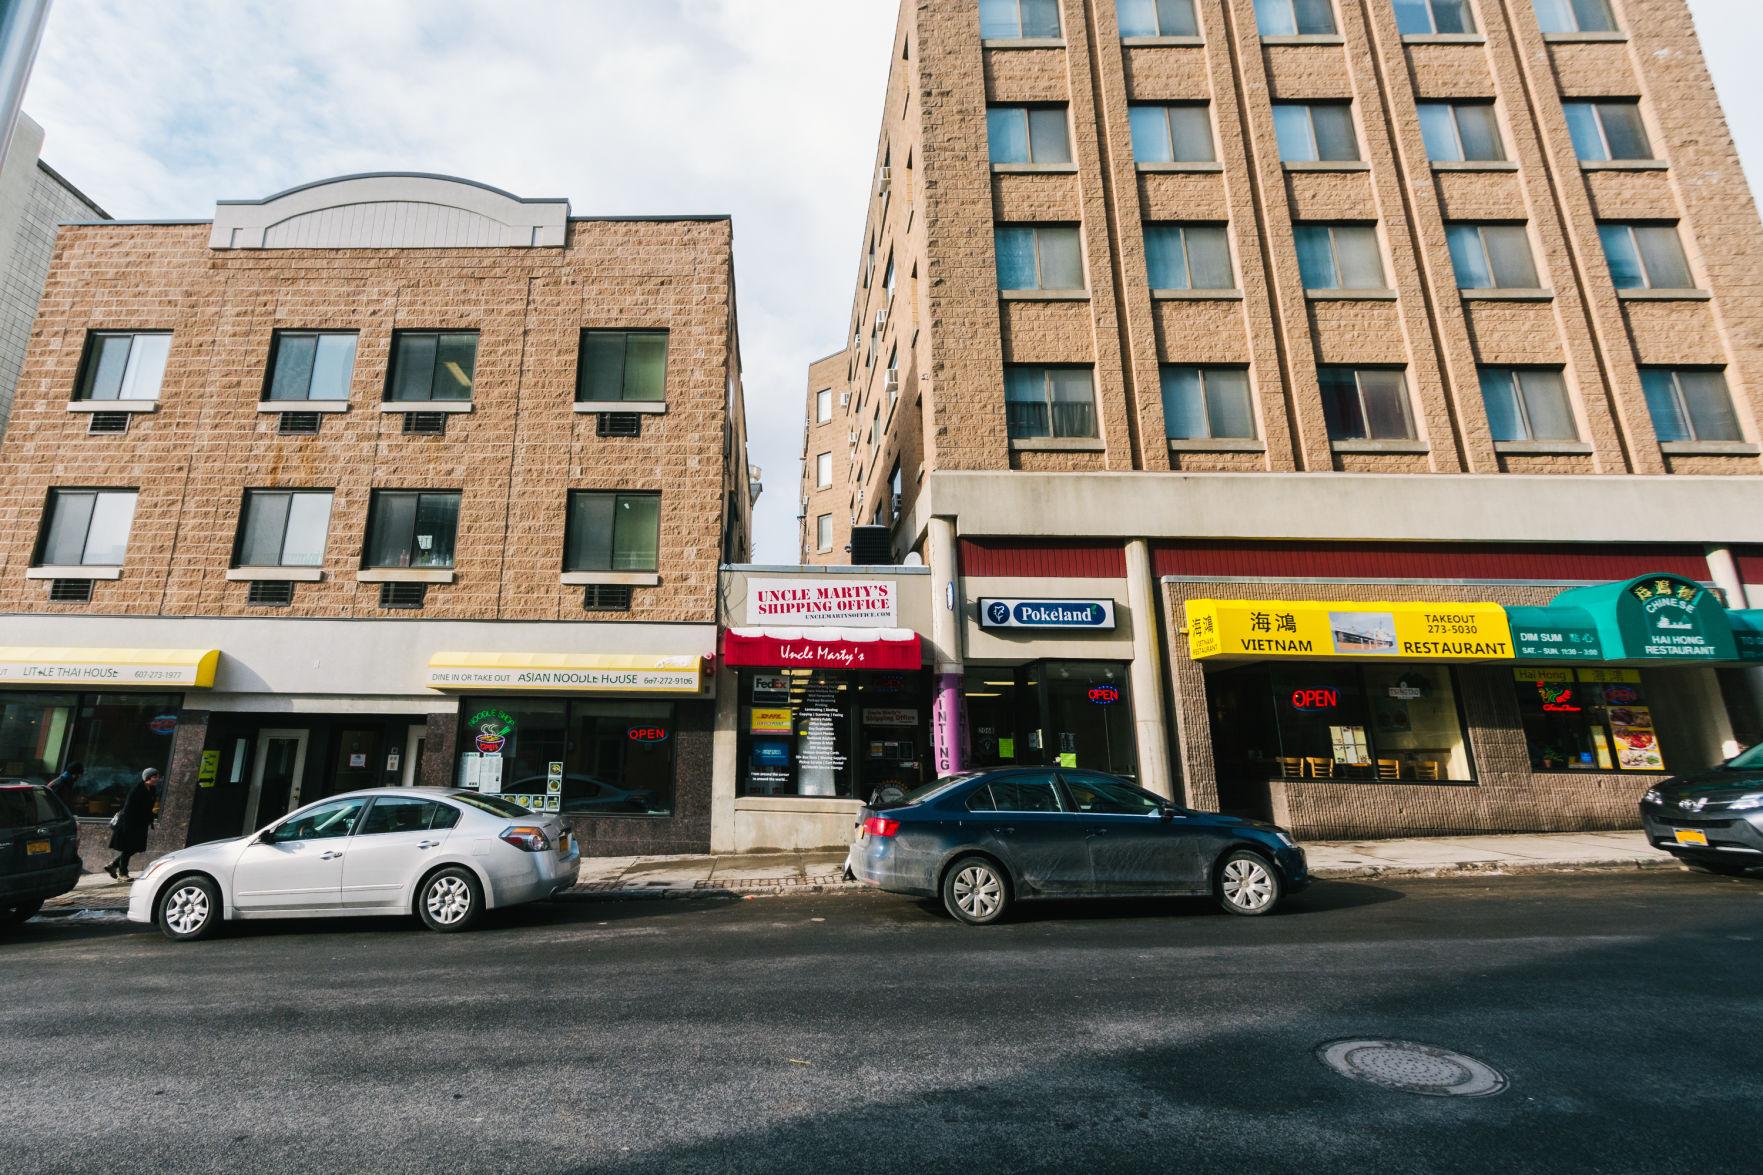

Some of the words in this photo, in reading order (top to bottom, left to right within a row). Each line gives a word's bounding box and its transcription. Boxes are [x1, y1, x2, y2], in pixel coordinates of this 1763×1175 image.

[758, 588, 811, 602] UNCLE
[817, 584, 889, 600] MARTY'S
[758, 601, 832, 615] SHIPPING
[837, 598, 890, 612] OFFICE
[1646, 597, 1696, 614] CHINESE
[805, 611, 891, 620] UNCLEMARTYSOFFICE.COM
[1021, 606, 1093, 622] Pokéland
[1424, 614, 1476, 624] TAKEOUT
[1427, 624, 1478, 635] 273-5030
[1519, 632, 1538, 641] DIM
[1540, 633, 1563, 642] SUM
[1651, 635, 1671, 644] HAI
[1672, 635, 1705, 645] HONG
[1241, 638, 1313, 652] VIETNAM
[1404, 641, 1507, 655] RESTAURANT
[1645, 645, 1716, 655] RESTAURANT
[780, 645, 814, 660] Uncle
[817, 646, 865, 666] Marty's
[57, 667, 81, 678] THAI
[84, 667, 119, 679] HOUSE
[134, 671, 182, 680] 607-273-1977
[432, 673, 450, 681] DINE
[451, 673, 460, 681] IN
[474, 674, 492, 682] TAKE
[494, 674, 511, 682] OUT
[517, 672, 550, 683] ASIAN
[601, 674, 638, 684] HOUSE
[1519, 670, 1536, 679] Hai
[1537, 670, 1567, 681] Hong
[755, 678, 786, 689] FedEx
[1088, 689, 1119, 701] OPEN
[1292, 689, 1337, 707] OPEN
[467, 709, 497, 727] NOODLE
[629, 728, 665, 740] OPEN
